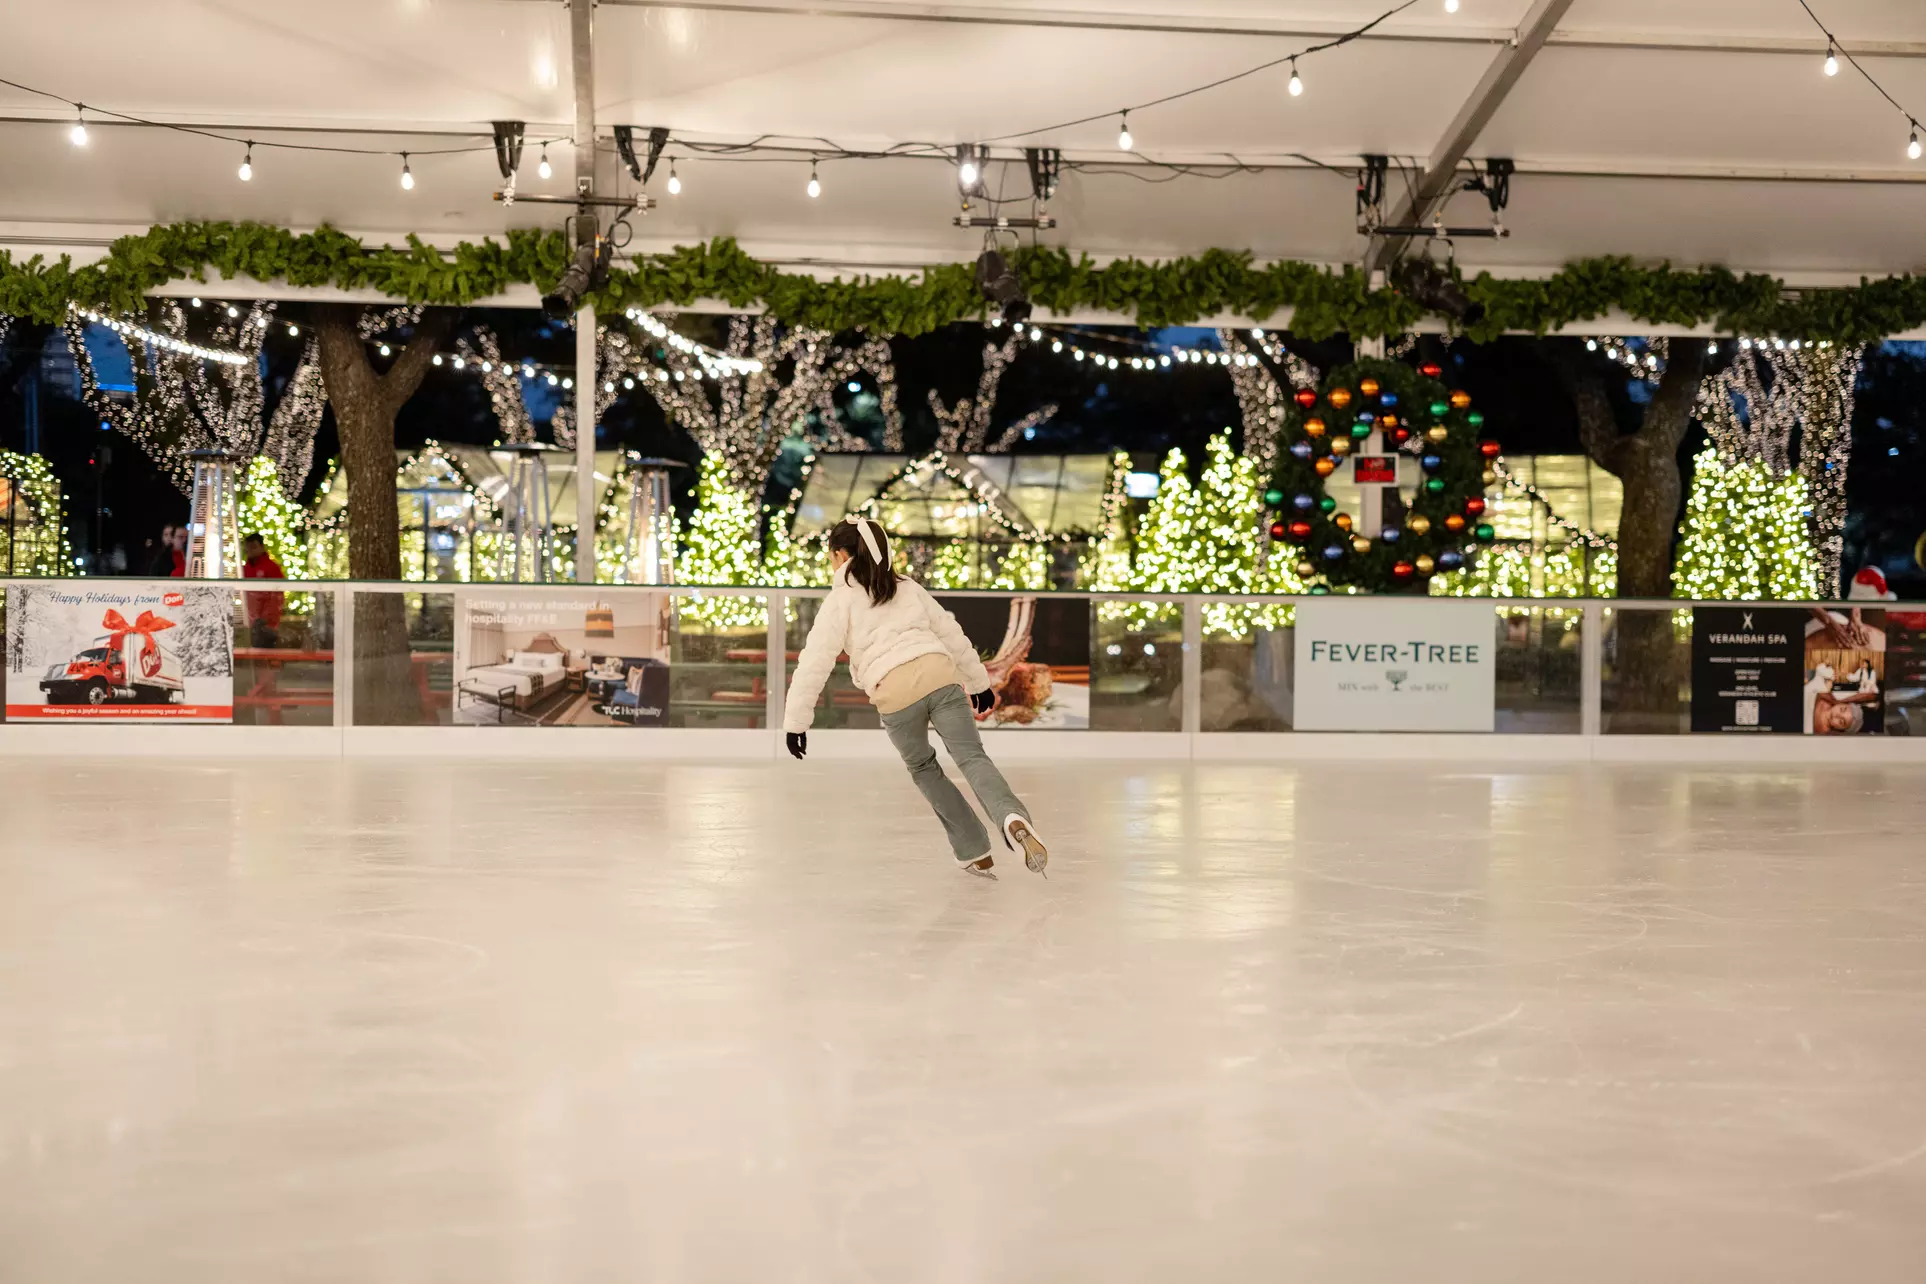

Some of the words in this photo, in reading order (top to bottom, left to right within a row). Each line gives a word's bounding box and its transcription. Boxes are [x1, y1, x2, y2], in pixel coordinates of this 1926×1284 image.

[49, 591, 82, 605] Happy
[85, 591, 131, 606] Holidays
[133, 594, 159, 606] from
[464, 599, 506, 611] Setting
[509, 601, 516, 610] a
[519, 601, 543, 610] new
[546, 600, 597, 610] standard
[599, 600, 610, 610] in
[464, 612, 524, 625] hospitality
[1709, 633, 1765, 644] VERANDAH
[1768, 634, 1787, 644] SPA
[1311, 640, 1480, 663] FEVER-TREE
[42, 707, 65, 715] Wishing
[65, 708, 77, 716] you
[82, 707, 98, 715] joyful
[140, 708, 164, 716] amazing
[164, 708, 177, 716] year
[601, 705, 620, 715] TLC
